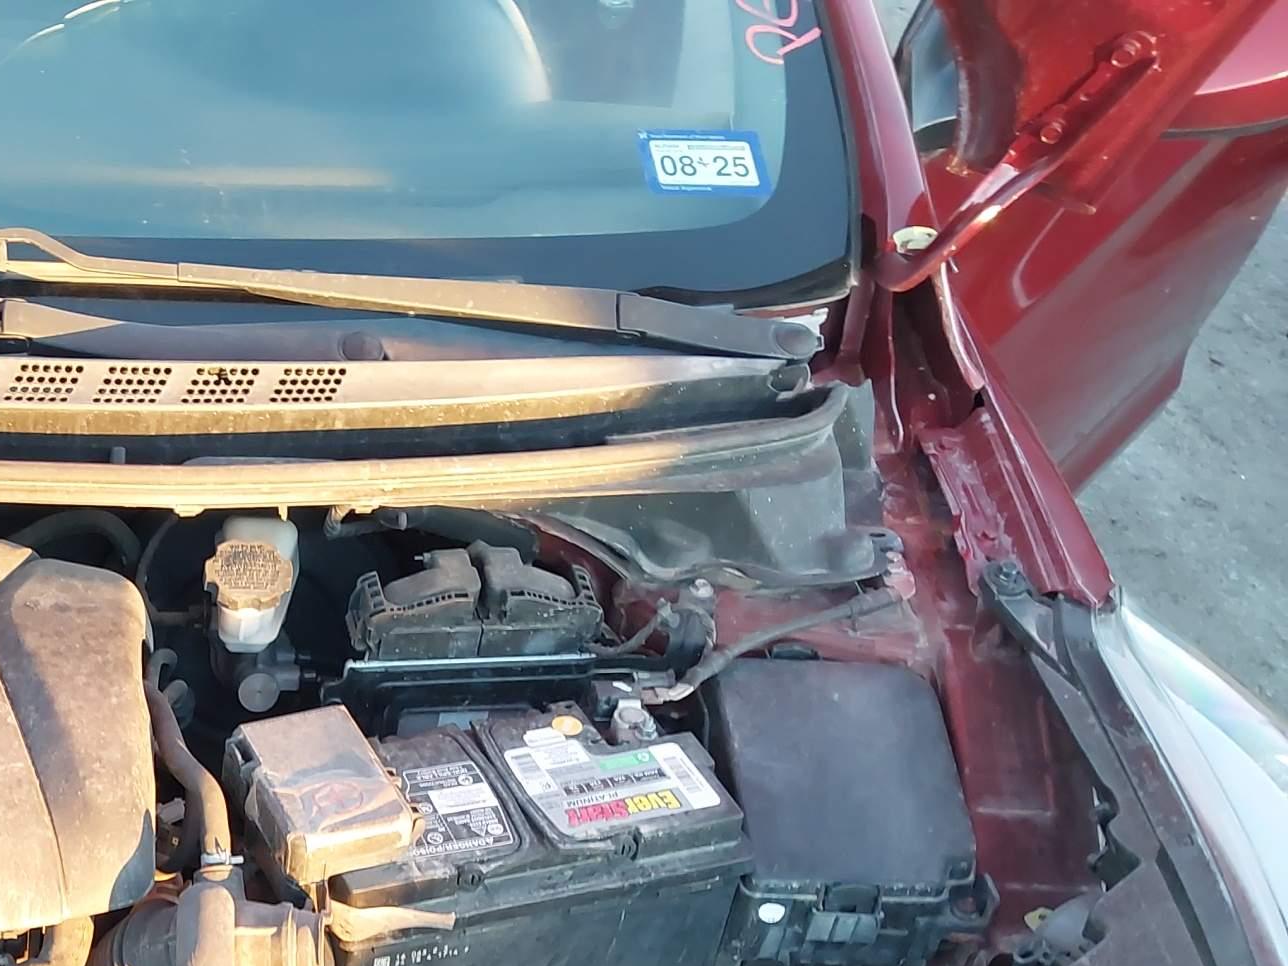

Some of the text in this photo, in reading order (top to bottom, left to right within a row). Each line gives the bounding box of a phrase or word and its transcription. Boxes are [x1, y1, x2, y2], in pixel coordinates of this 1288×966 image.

[660, 155, 749, 177] 08 25
[565, 789, 681, 827] EverStart
